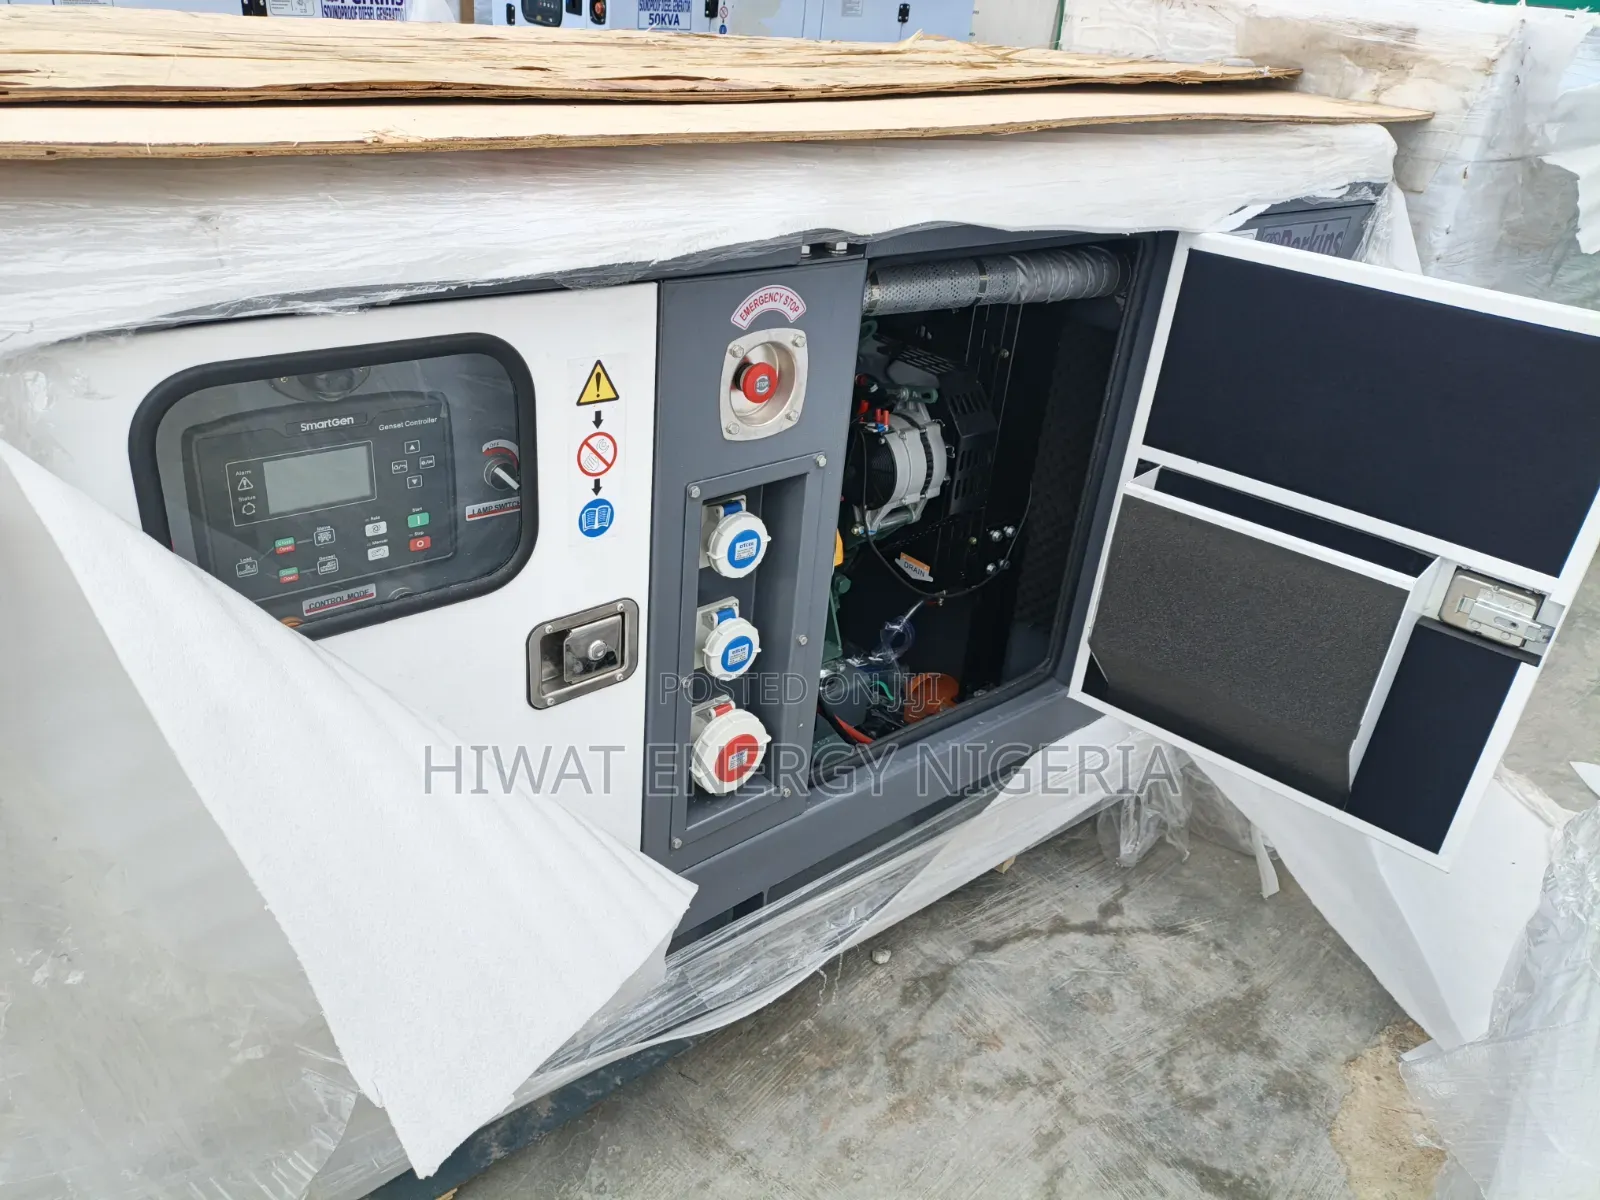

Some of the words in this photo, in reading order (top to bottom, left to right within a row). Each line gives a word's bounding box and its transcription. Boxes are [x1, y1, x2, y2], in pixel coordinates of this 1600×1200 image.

[648, 12, 680, 26] 50KVA
[739, 291, 783, 322] EMERGENCY
[783, 295, 800, 314] STOP
[300, 416, 354, 432] SmartGen
[378, 422, 404, 431] Genset
[404, 417, 438, 427] Controller
[471, 505, 493, 515] LAMP
[903, 561, 926, 578] DRAIN
[308, 595, 345, 610] CONTROL
[347, 588, 370, 600] MODE
